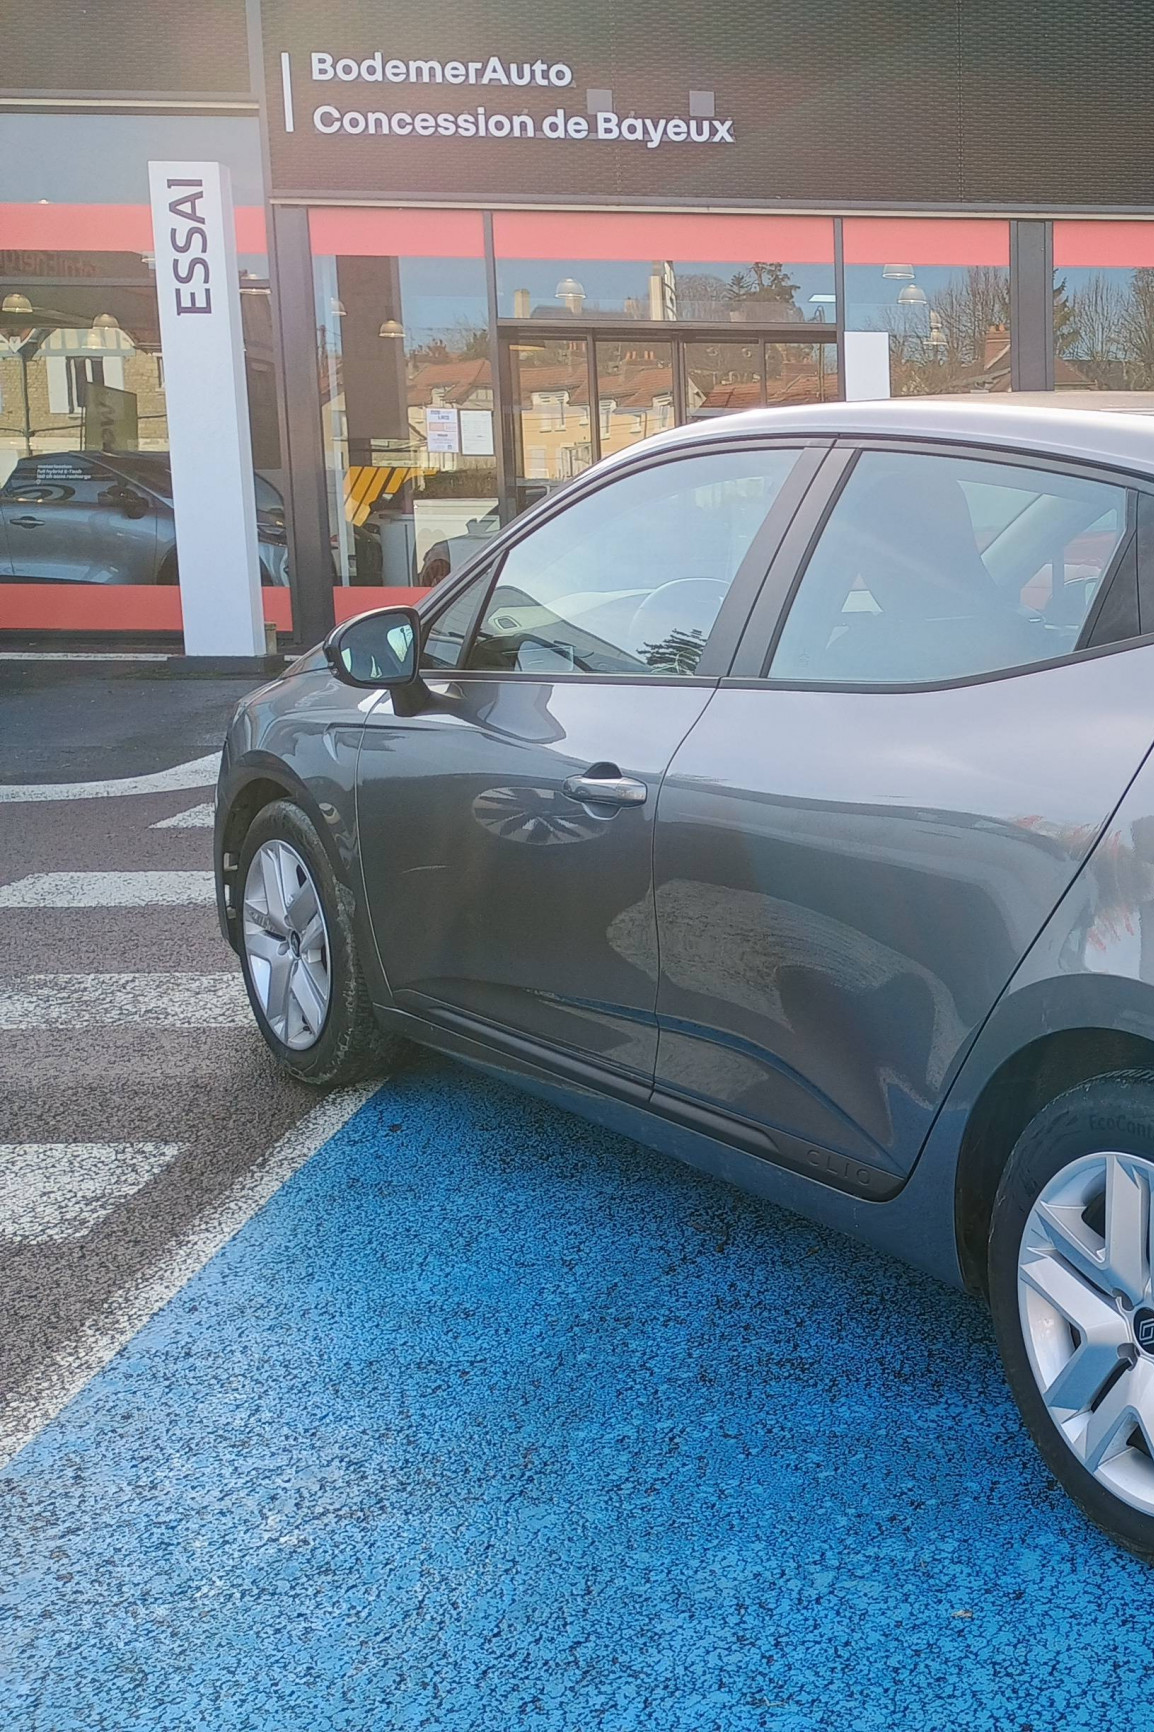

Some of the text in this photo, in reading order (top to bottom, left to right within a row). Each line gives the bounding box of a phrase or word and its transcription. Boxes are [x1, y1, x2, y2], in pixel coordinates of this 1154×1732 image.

[311, 51, 574, 88] BodemerAuto
[312, 105, 735, 148] Concession de Bayeux
[167, 179, 212, 316] ESSAI
[806, 1149, 872, 1186] CLIO
